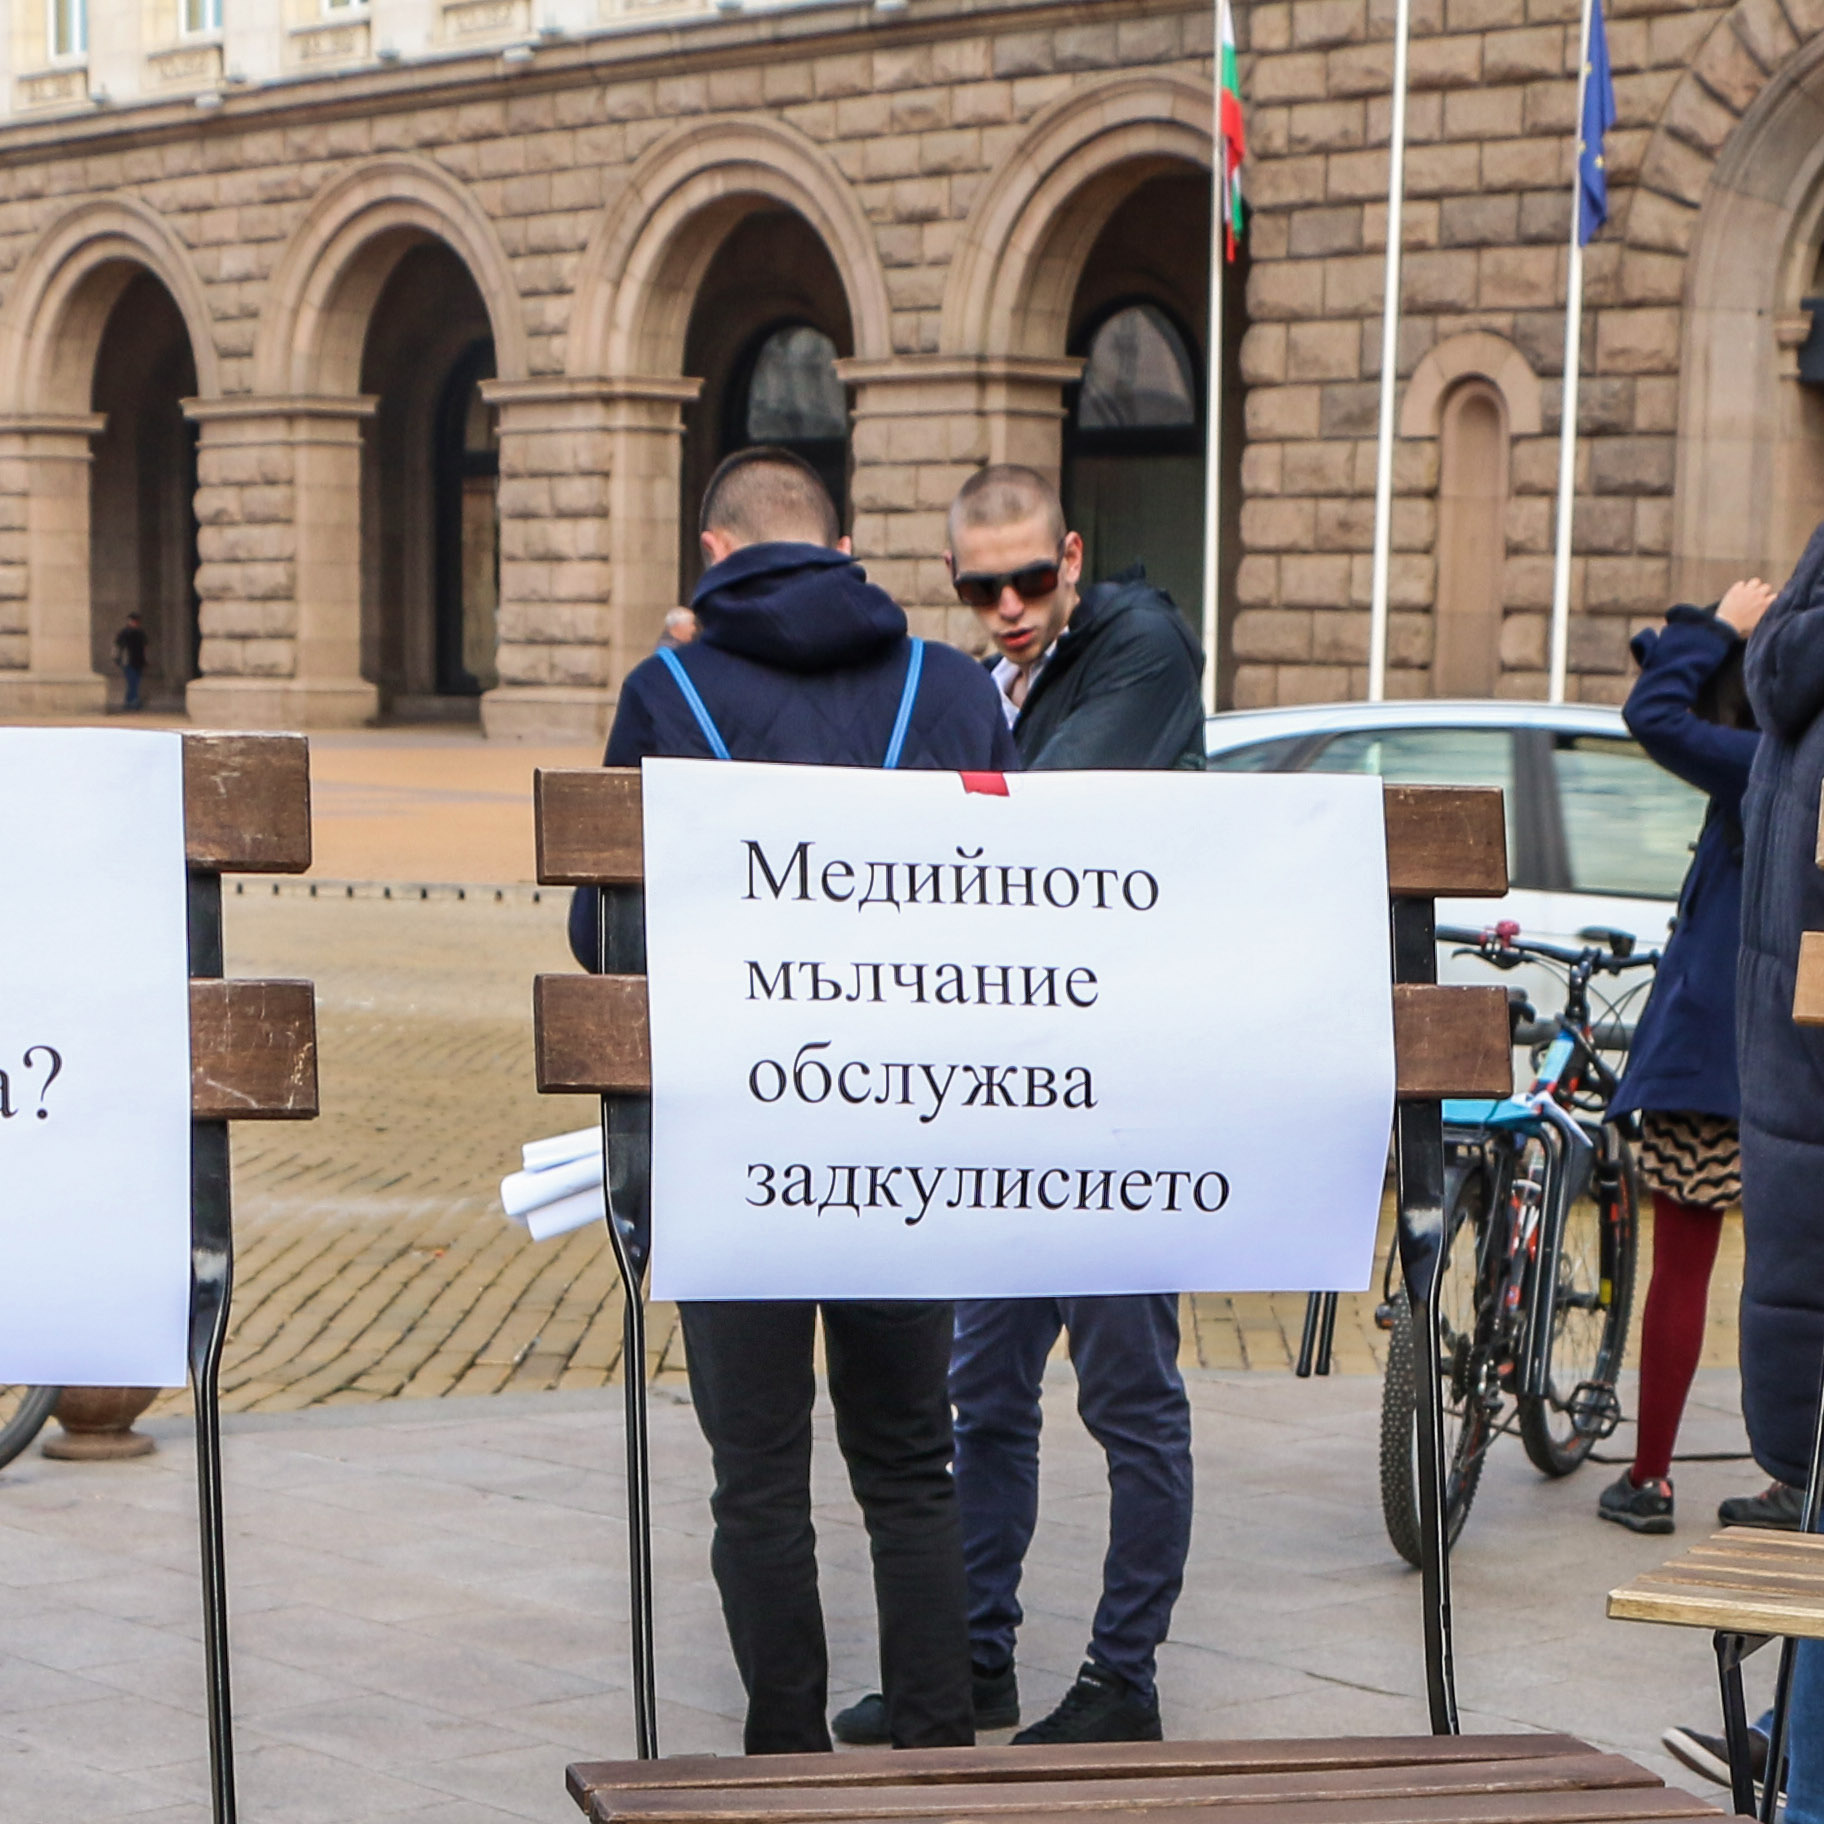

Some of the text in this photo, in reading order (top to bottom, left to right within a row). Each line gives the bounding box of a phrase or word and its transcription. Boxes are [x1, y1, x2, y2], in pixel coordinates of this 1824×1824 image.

[740, 839, 1160, 914] Медийното
[743, 959, 1099, 1009] мълчание
[748, 1040, 1099, 1125] обслужва
[745, 1162, 1230, 1227] задкулисието
